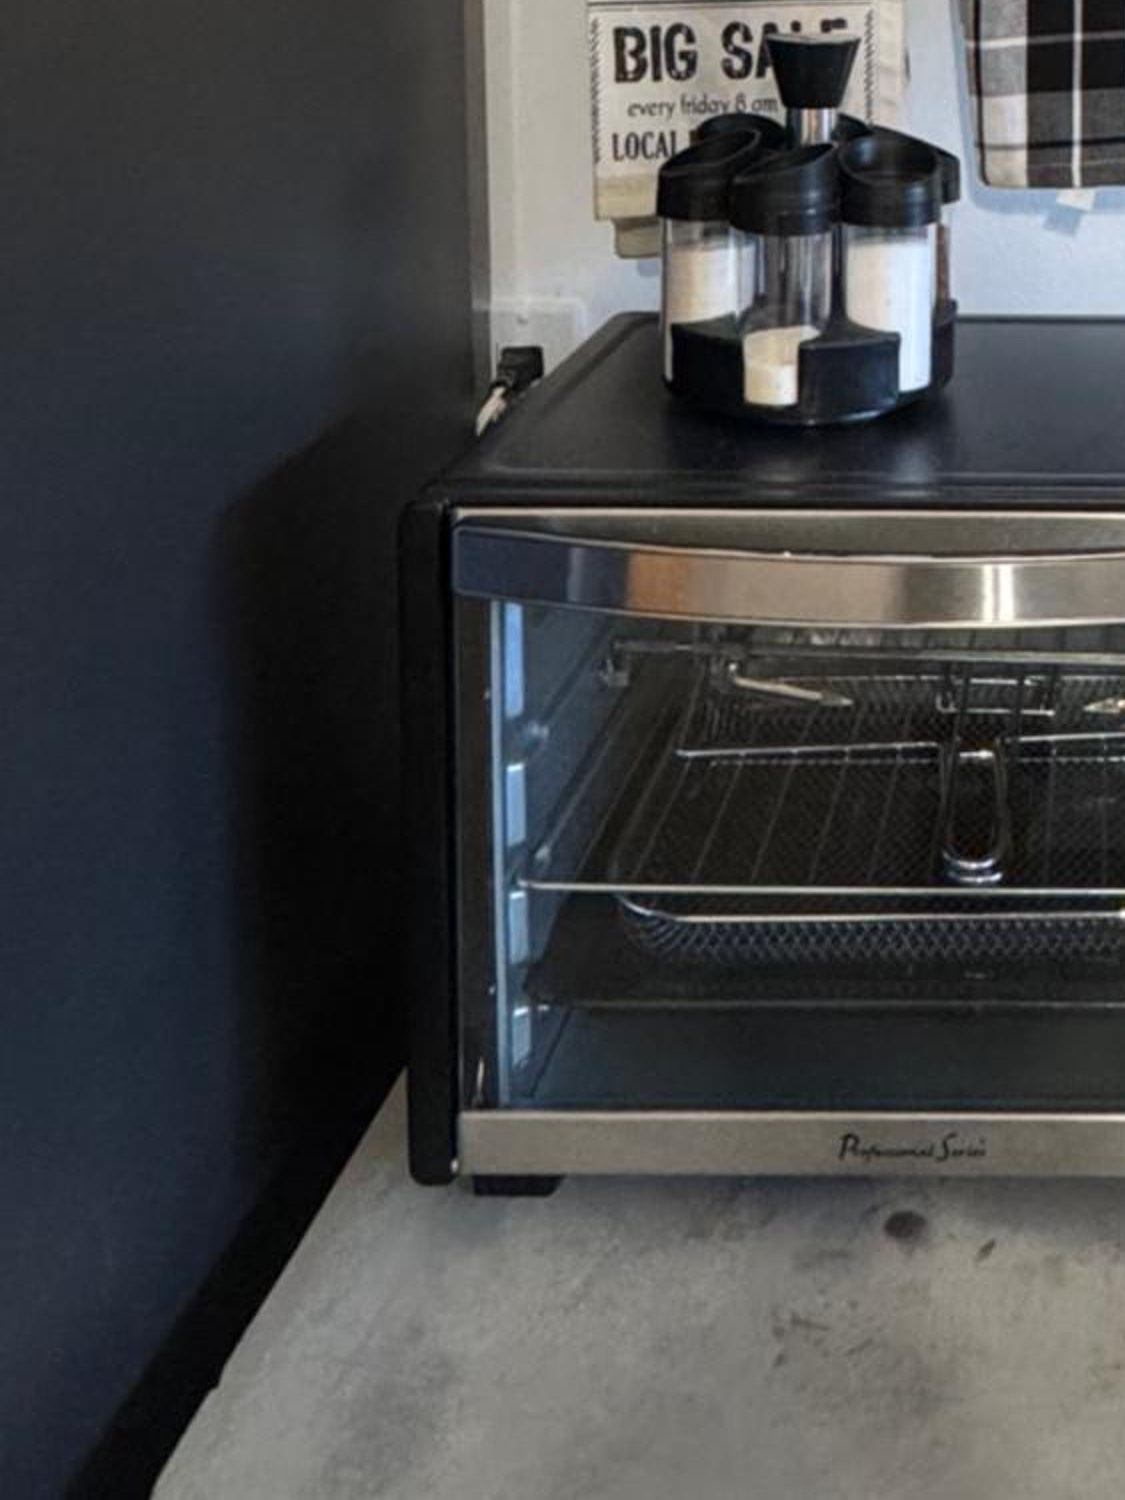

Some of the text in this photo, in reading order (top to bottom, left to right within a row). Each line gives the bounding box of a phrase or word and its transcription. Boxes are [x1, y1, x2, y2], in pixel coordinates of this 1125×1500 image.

[613, 23, 697, 84] BIG
[627, 100, 676, 119] every
[680, 93, 730, 115] friday
